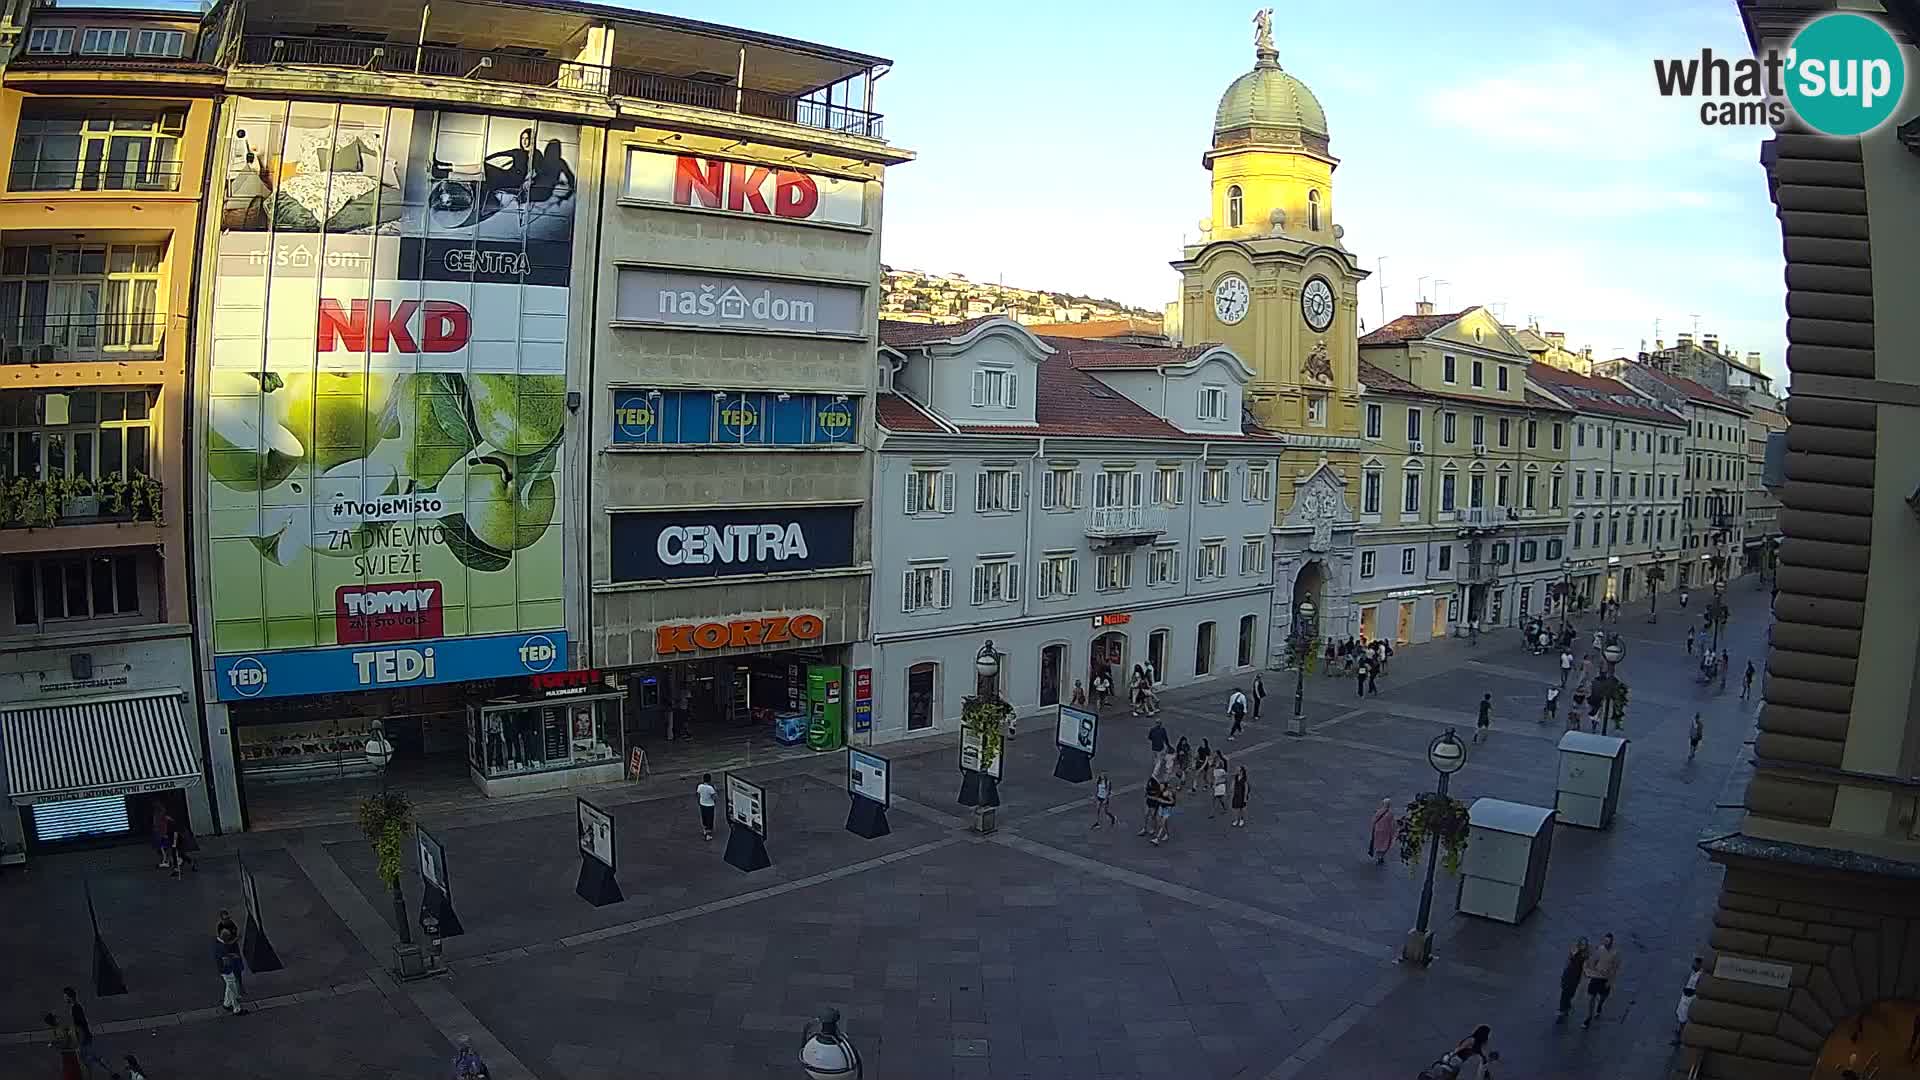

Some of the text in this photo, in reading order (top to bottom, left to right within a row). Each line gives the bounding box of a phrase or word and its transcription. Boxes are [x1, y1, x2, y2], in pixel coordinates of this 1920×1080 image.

[675, 156, 819, 219] NKD
[444, 249, 531, 275] CENTRA
[659, 284, 815, 323] naš dom
[316, 298, 473, 353] NKD
[616, 408, 655, 426] TEDi
[721, 409, 758, 427] TEDi
[818, 410, 851, 428] TEDi
[333, 498, 442, 518] #TvojeMisto
[328, 525, 446, 550] ZA DNEVNO
[657, 522, 808, 565] CENTRA
[354, 548, 422, 577] SVJEŽE
[344, 588, 435, 617] TOMMY
[656, 614, 824, 655] KORZO
[352, 647, 436, 685] TEDi
[518, 643, 557, 663] TEDi
[228, 666, 268, 687] TEDi
